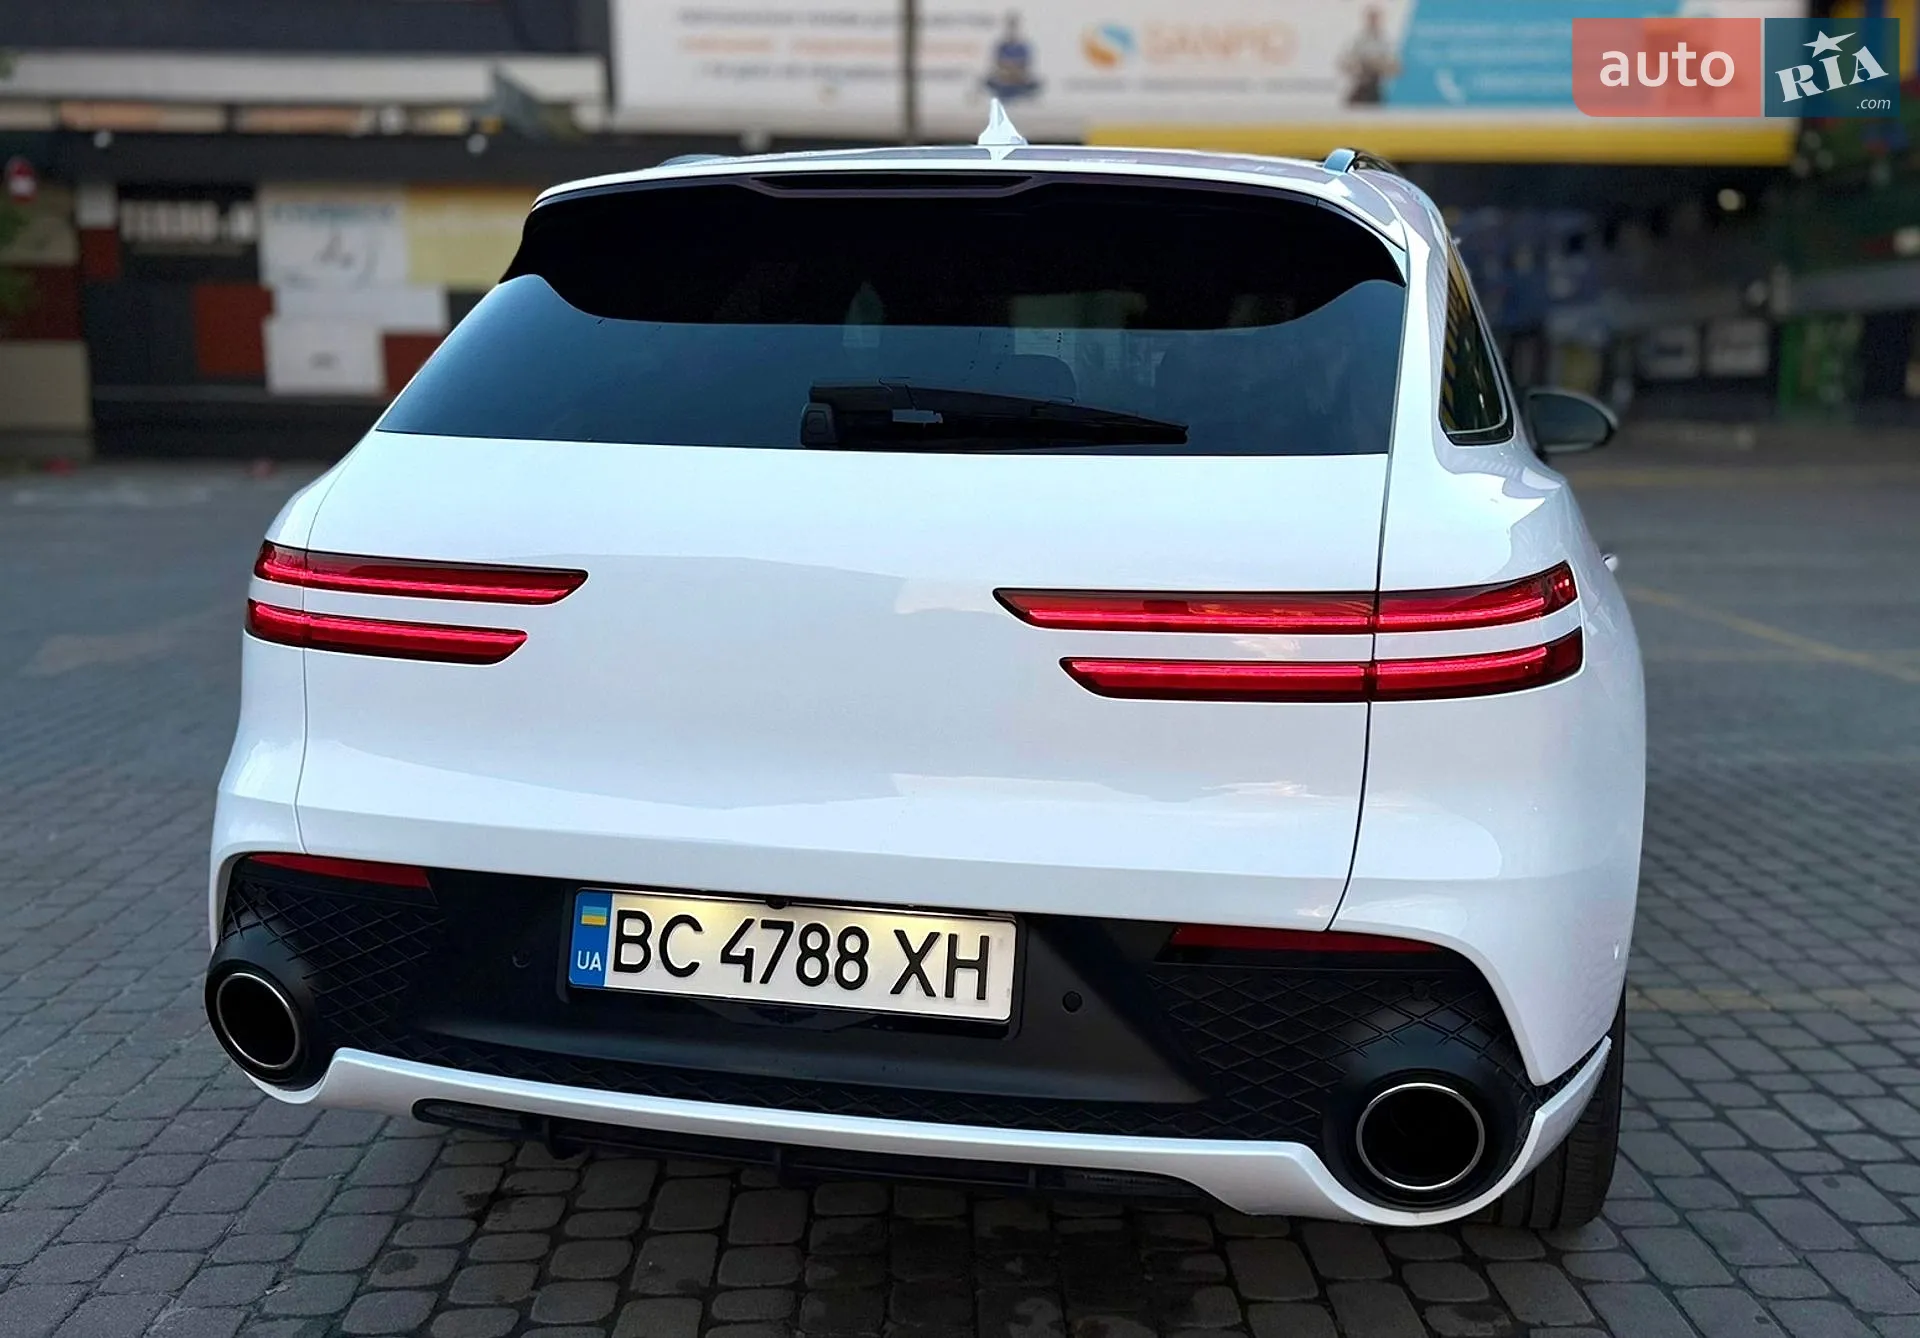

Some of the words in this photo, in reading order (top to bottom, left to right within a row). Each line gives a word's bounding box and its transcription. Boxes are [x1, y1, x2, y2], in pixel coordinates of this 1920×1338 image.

[577, 950, 602, 972] UA
[614, 909, 704, 978] BC
[720, 918, 869, 991] 4788
[890, 929, 990, 1000] XH
